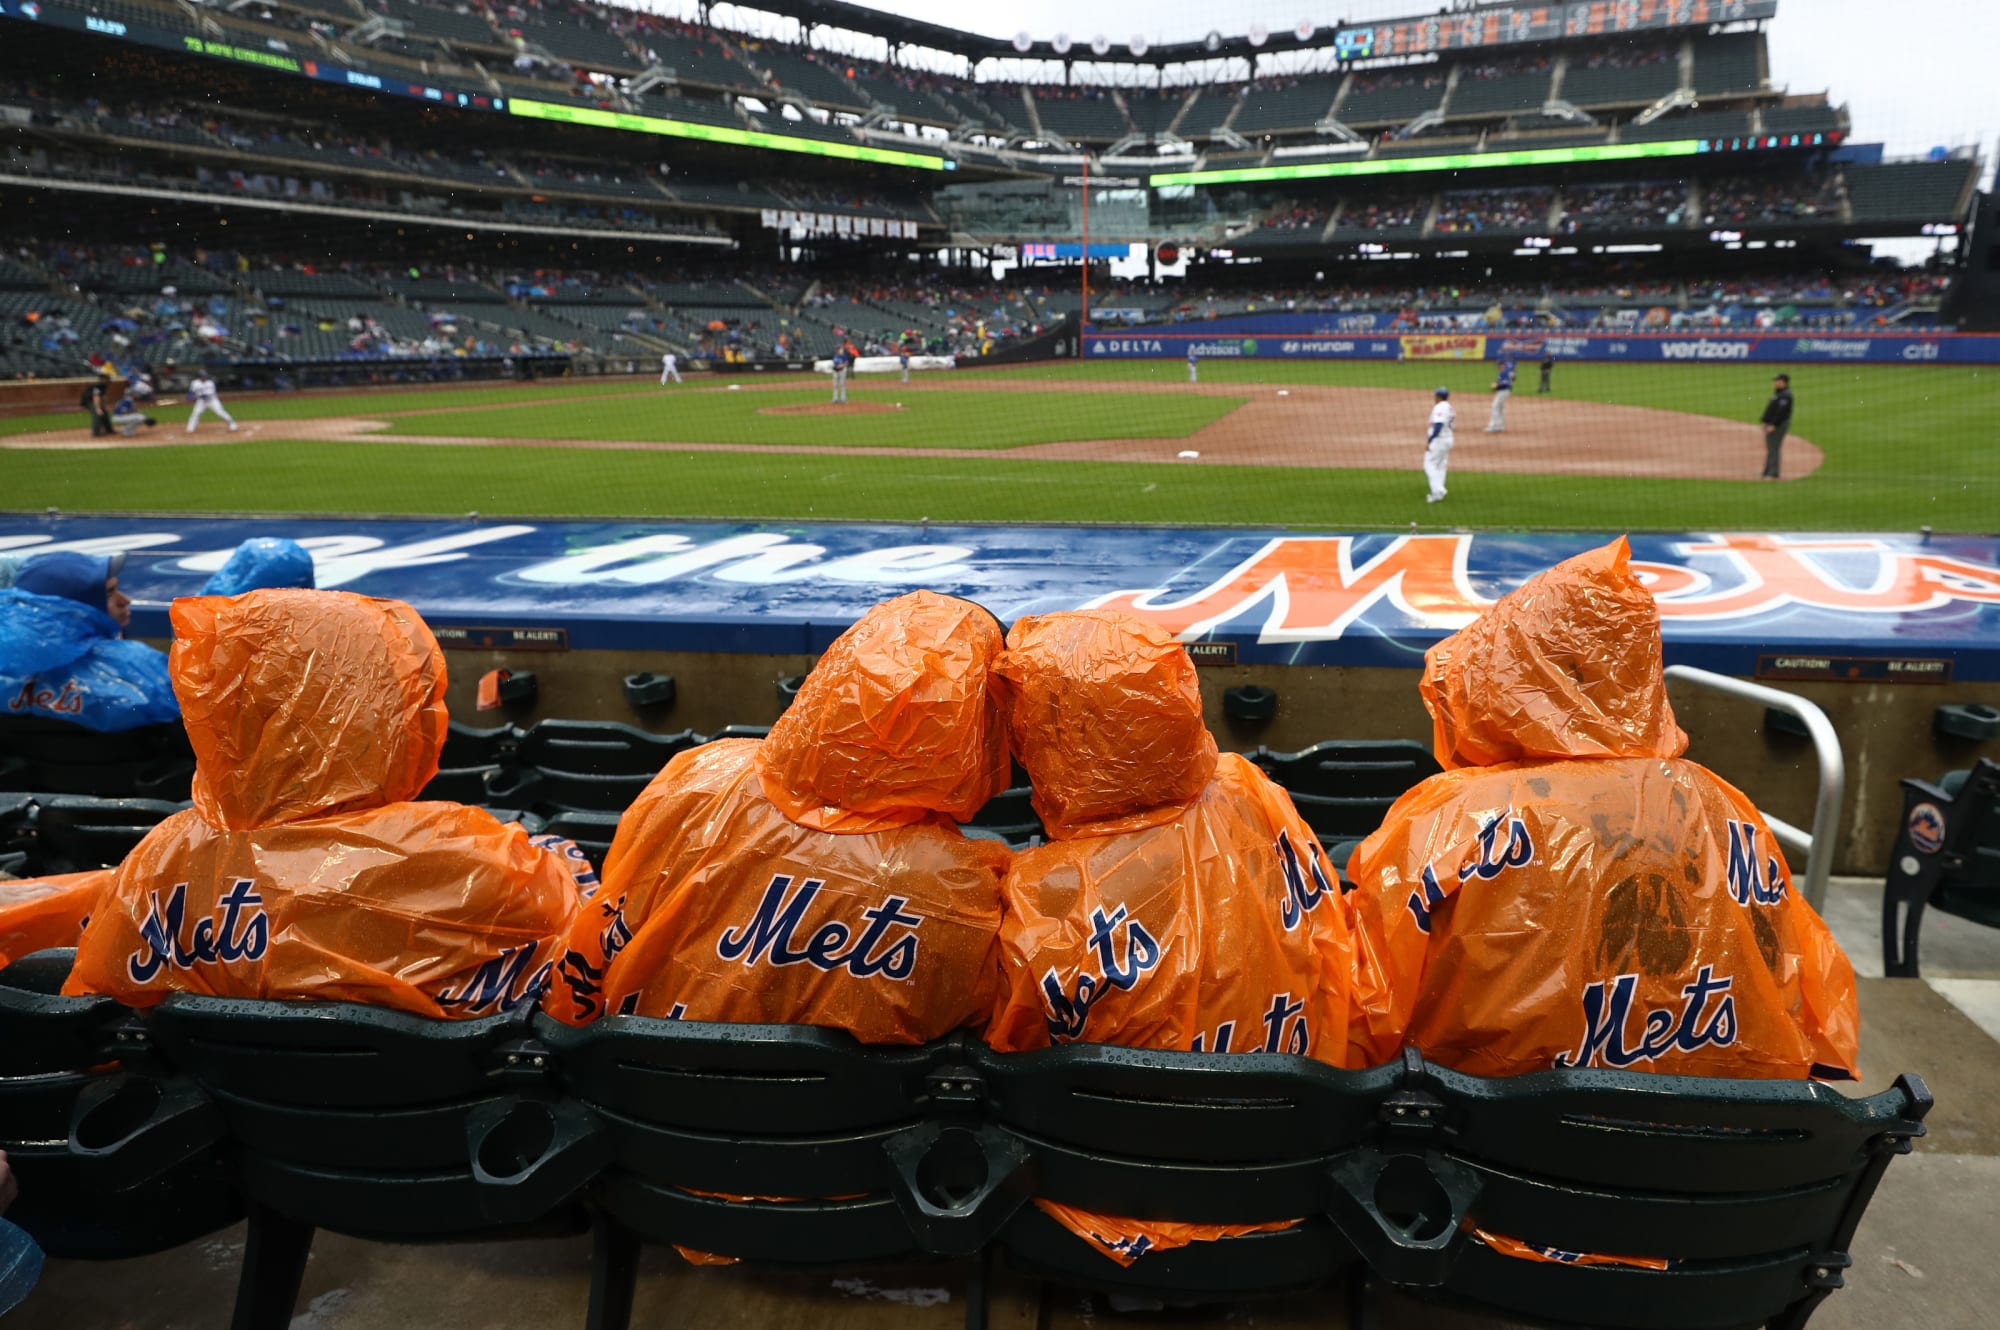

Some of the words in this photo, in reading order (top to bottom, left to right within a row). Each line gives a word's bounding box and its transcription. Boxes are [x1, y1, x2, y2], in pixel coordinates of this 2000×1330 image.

[1109, 340, 1162, 352] DELTA
[1302, 342, 1354, 351] HYUNDAI
[1661, 339, 1749, 358] verizon
[1811, 339, 1871, 351] National
[1902, 342, 1939, 359] citi
[516, 532, 974, 584] the
[1193, 646, 1227, 655] ALERT!
[1775, 658, 1830, 669] CAUTION!
[1888, 661, 1901, 671] BE
[1904, 662, 1944, 672] ALERT!
[8, 676, 90, 714] Mets
[1727, 819, 1789, 907] Me
[127, 878, 270, 985] Mets
[717, 873, 925, 980] Mets
[1552, 965, 1738, 1070] Mets
